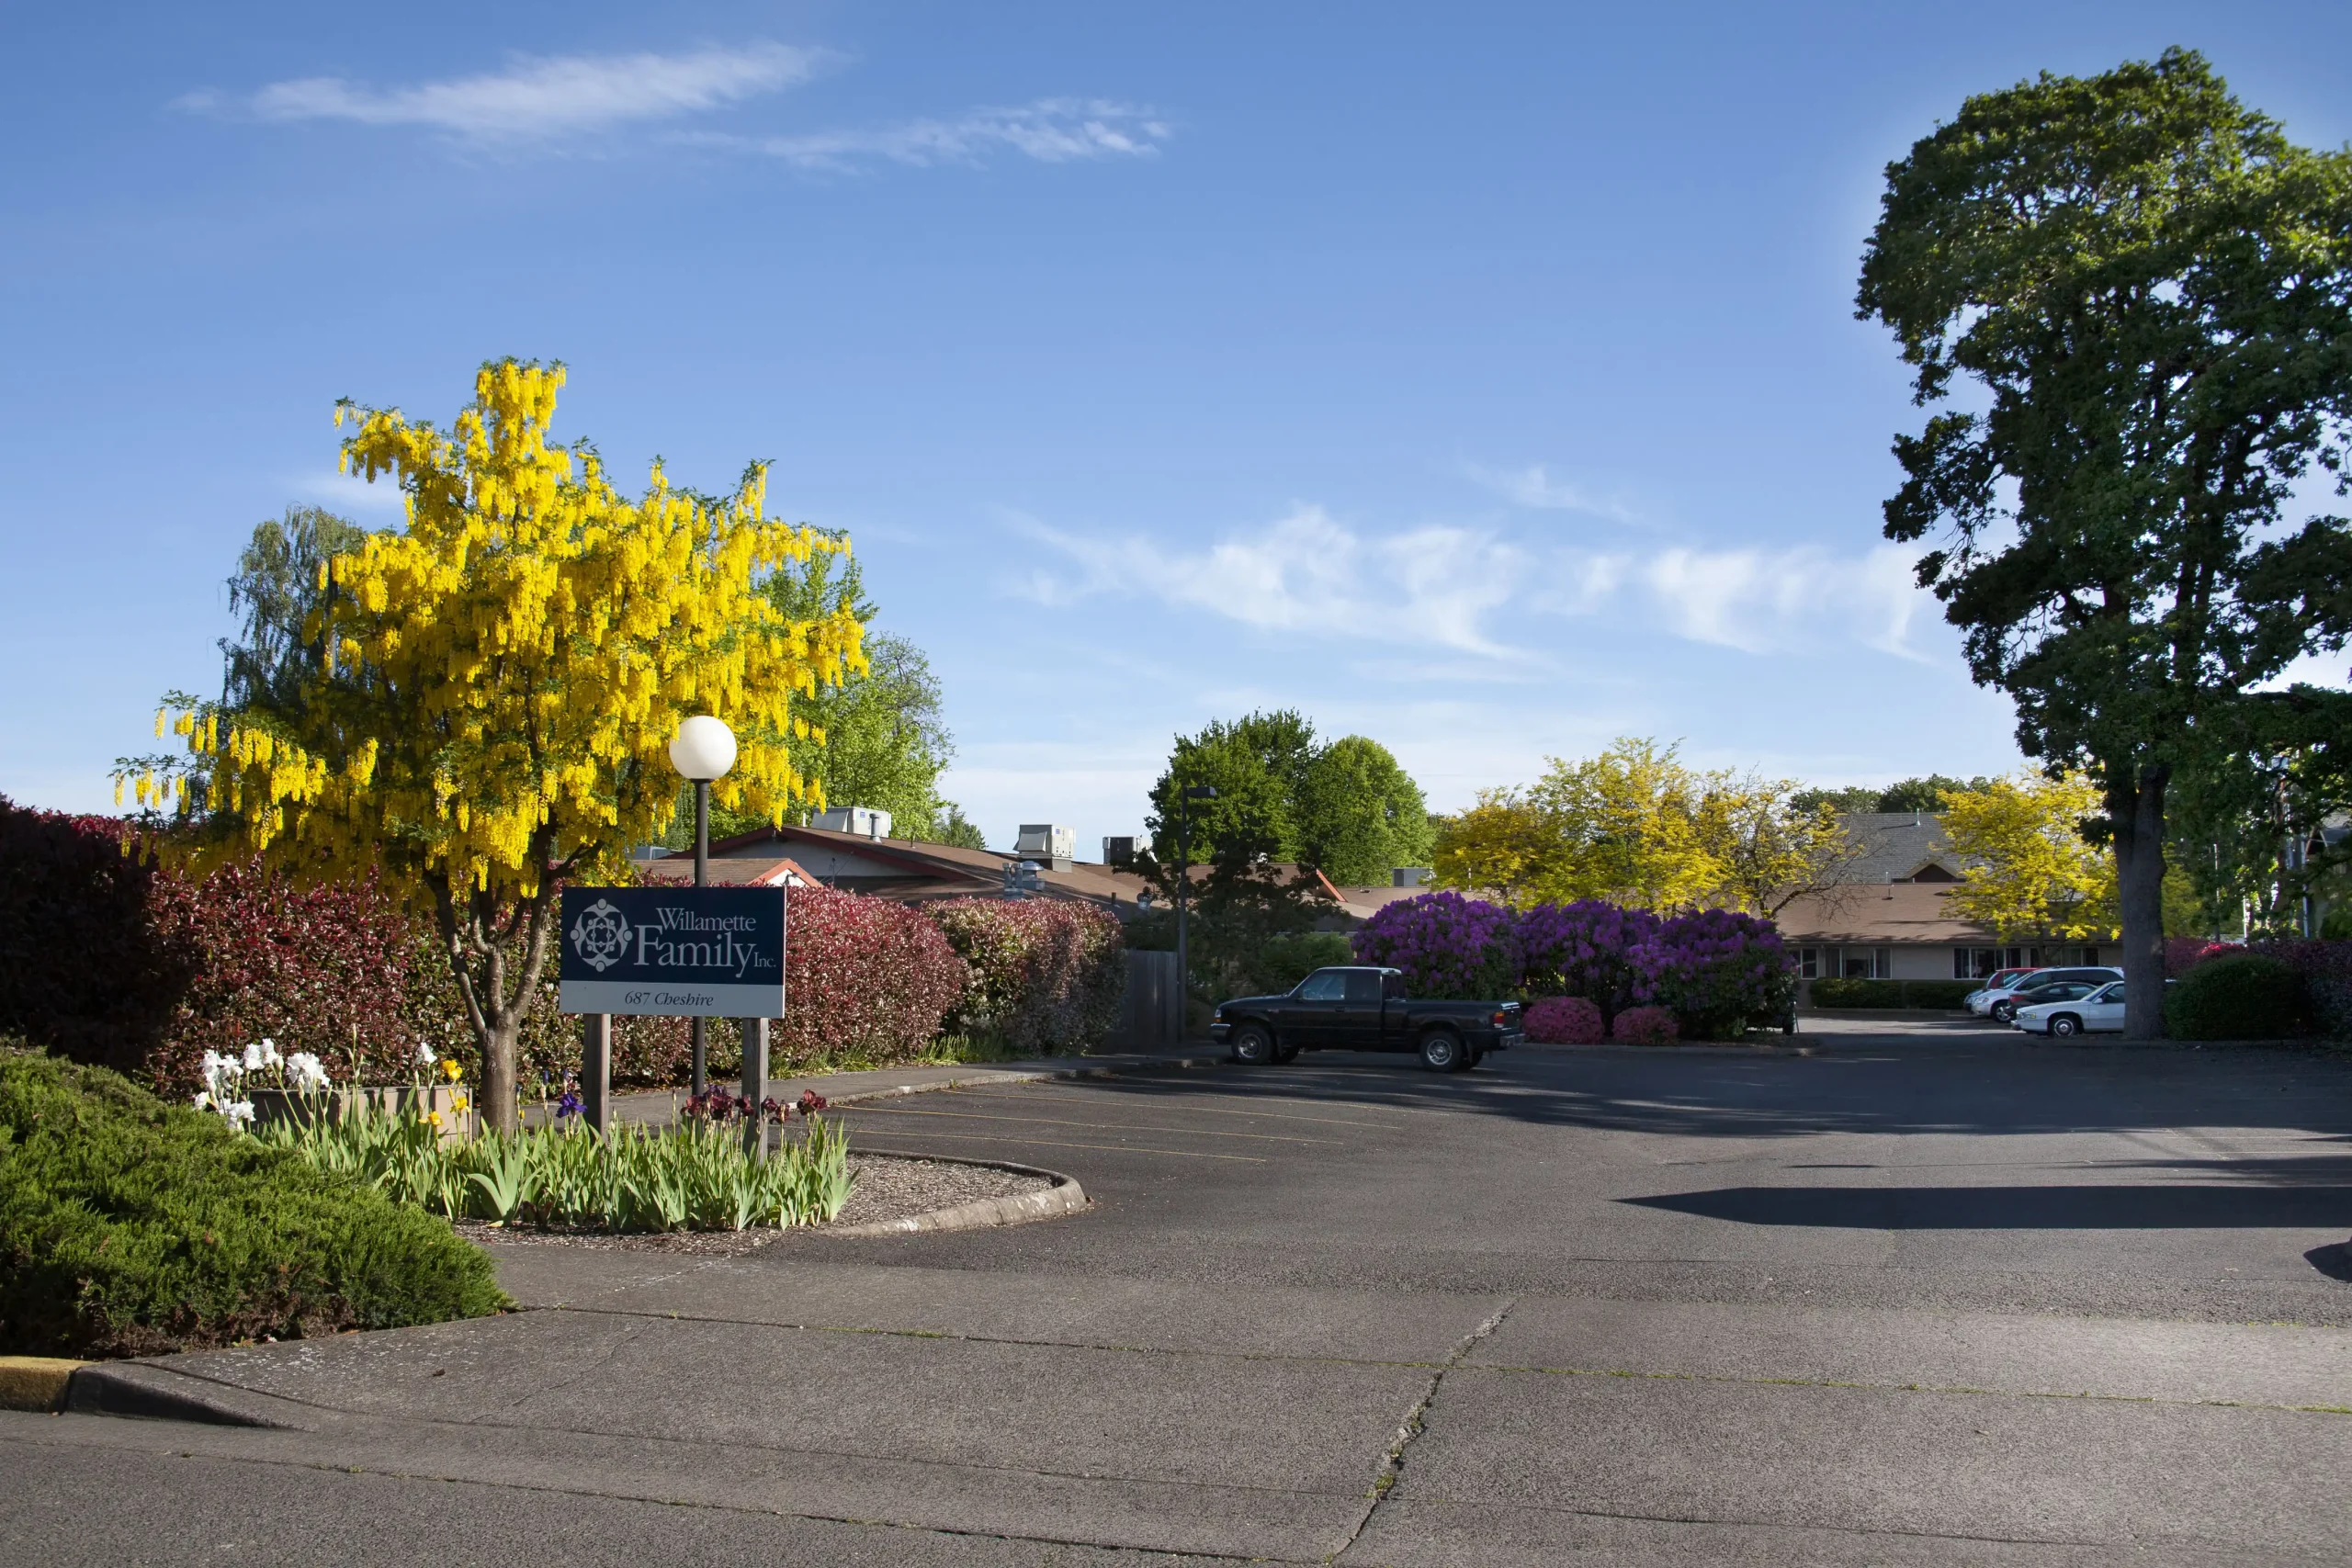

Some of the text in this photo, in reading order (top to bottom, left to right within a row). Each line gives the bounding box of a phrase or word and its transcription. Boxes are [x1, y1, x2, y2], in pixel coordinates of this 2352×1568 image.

[656, 908, 756, 931] Willamette
[634, 924, 776, 978] Family Inc.
[625, 990, 714, 1007] 687 Cheshire
